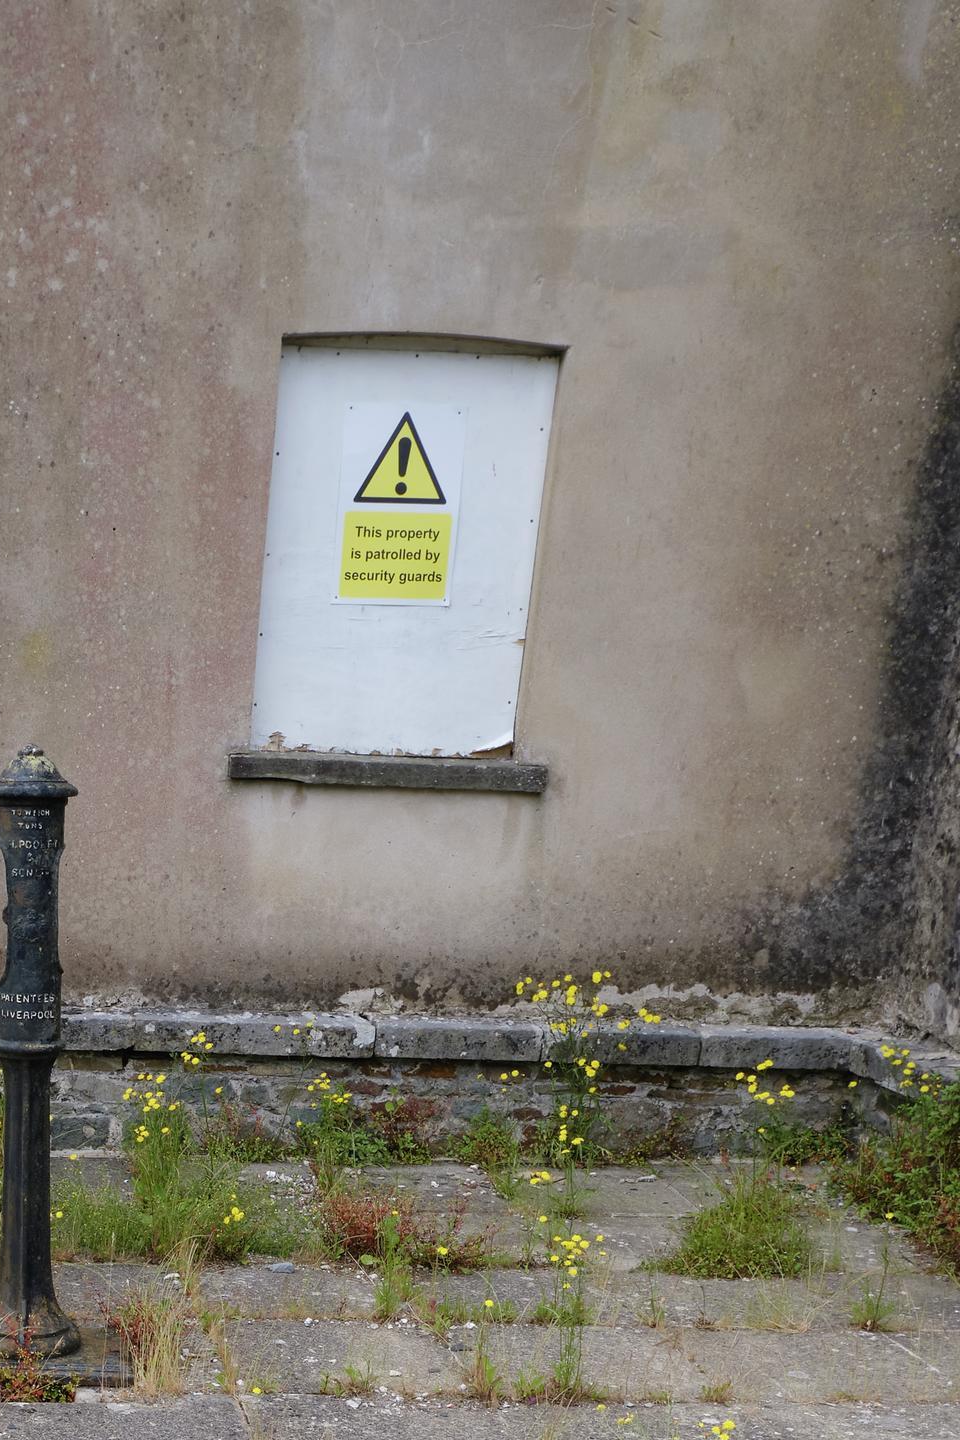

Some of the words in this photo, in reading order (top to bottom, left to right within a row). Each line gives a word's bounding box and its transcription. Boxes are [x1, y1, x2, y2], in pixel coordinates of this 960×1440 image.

[355, 526, 382, 538] This
[386, 527, 440, 541] property
[350, 548, 362, 559] is
[365, 548, 421, 563] patrolled
[425, 549, 441, 564] by
[344, 570, 395, 584] security
[399, 571, 442, 585] guards
[0, 993, 56, 1003] PATENTEES
[1, 1009, 55, 1020] LIVERPOOL
